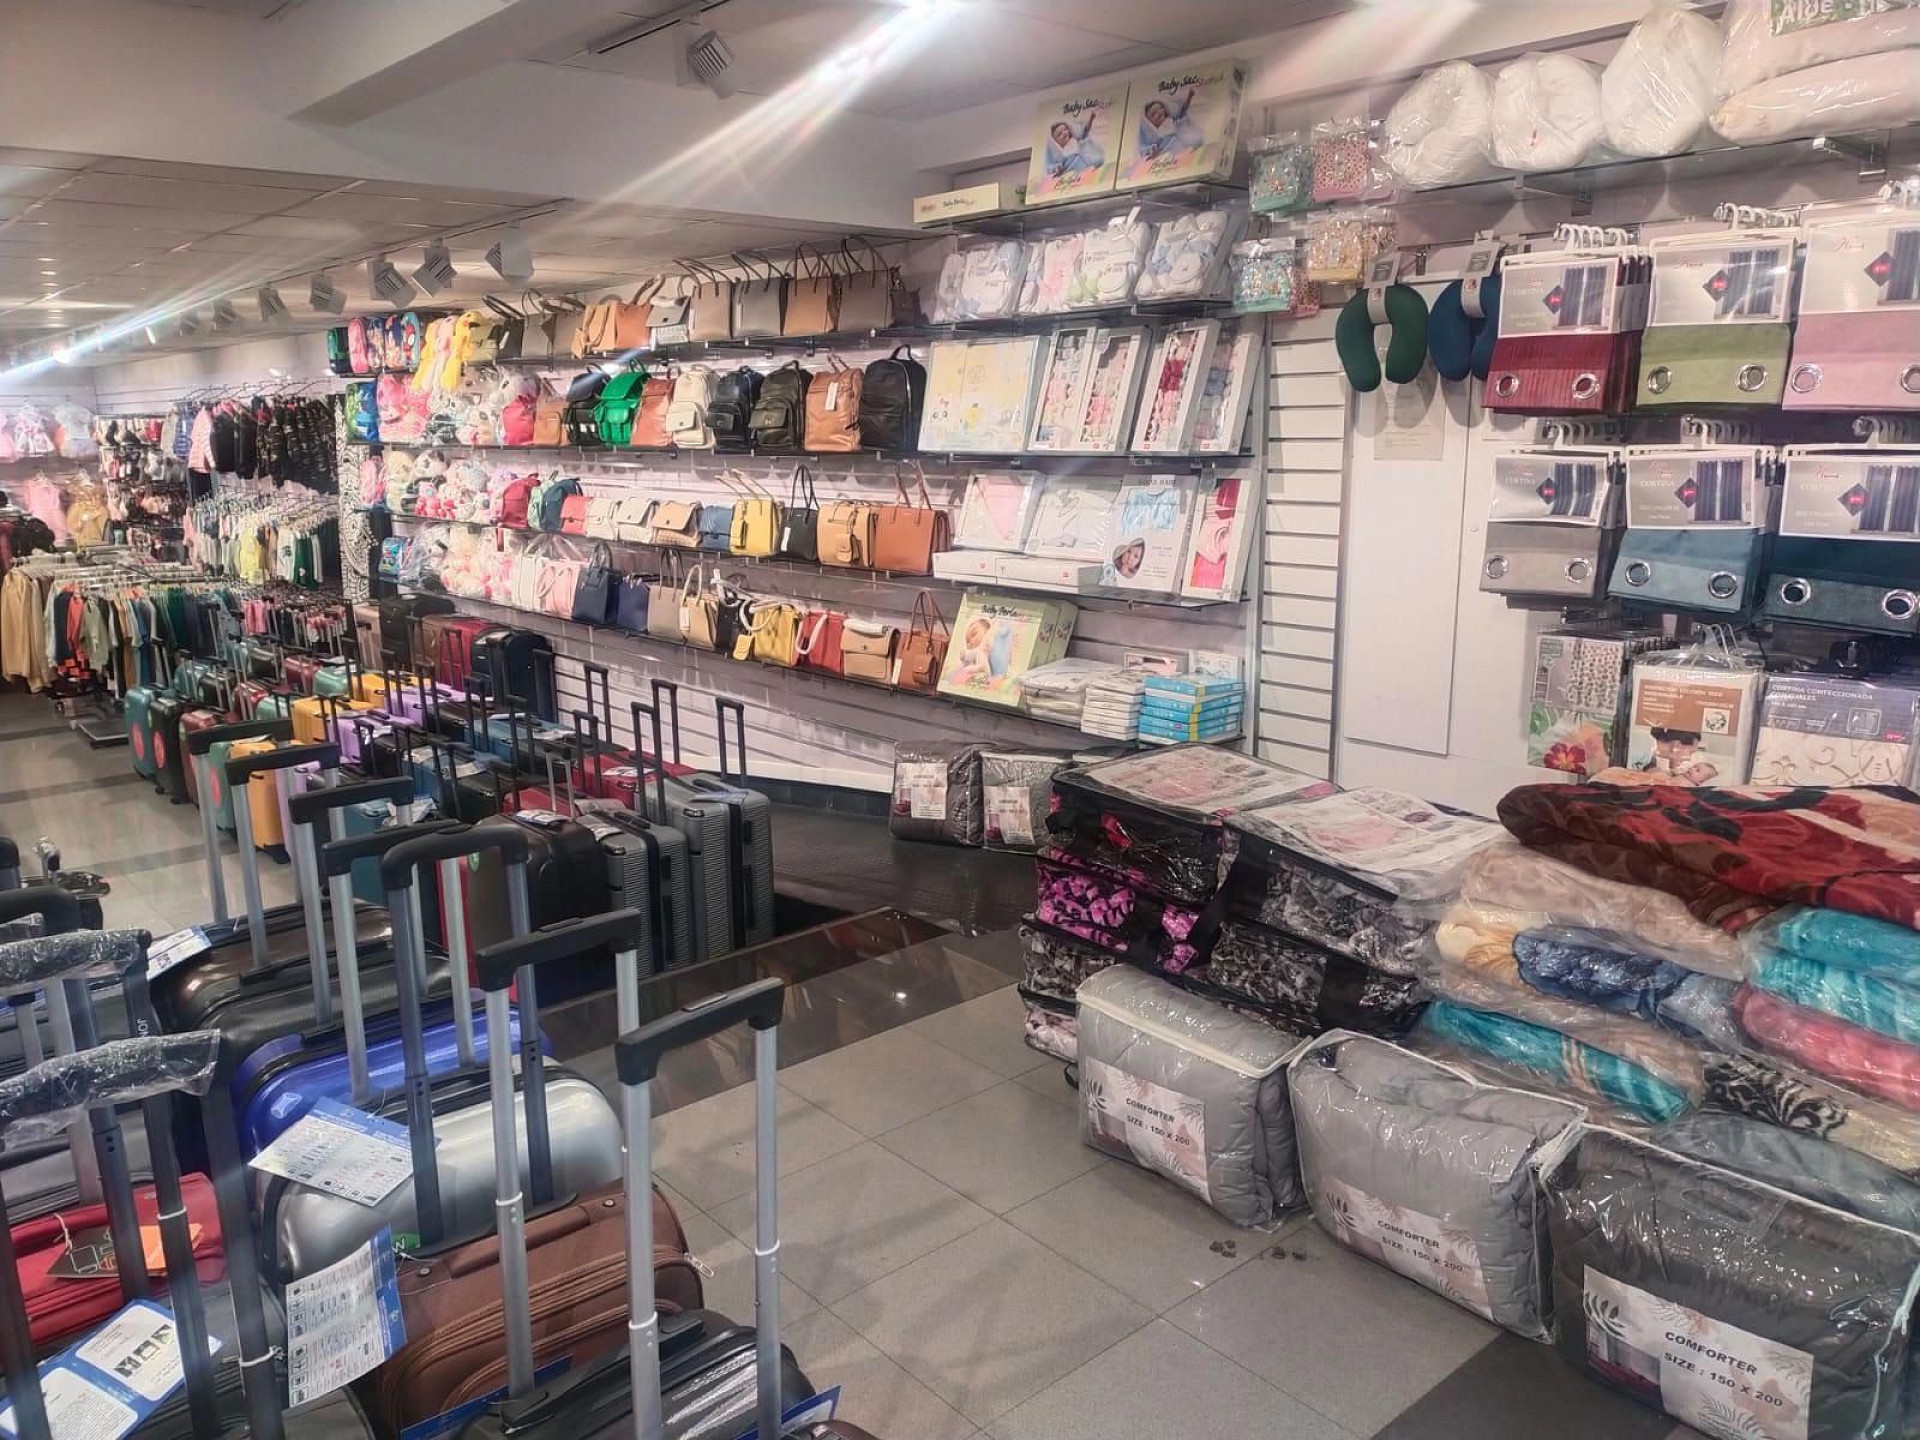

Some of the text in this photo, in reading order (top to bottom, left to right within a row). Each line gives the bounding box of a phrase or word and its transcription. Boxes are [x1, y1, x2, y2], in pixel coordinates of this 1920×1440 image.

[1772, 684, 1805, 695] CORTINA
[1126, 1097, 1175, 1122] COMFORTER
[1126, 1115, 1143, 1128] SIZE
[1151, 1125, 1165, 1136] 150
[1175, 1134, 1190, 1146] 200
[1377, 1220, 1440, 1248] COMFORTER
[1381, 1236, 1404, 1251] SIZE
[1413, 1249, 1430, 1261] 150
[1443, 1260, 1463, 1272] 200
[1665, 1331, 1758, 1375] COMFORTER
[1664, 1352, 1696, 1372] SIZE
[1710, 1372, 1735, 1388] 150
[1740, 1383, 1751, 1394] X
[1755, 1390, 1783, 1407] 200
